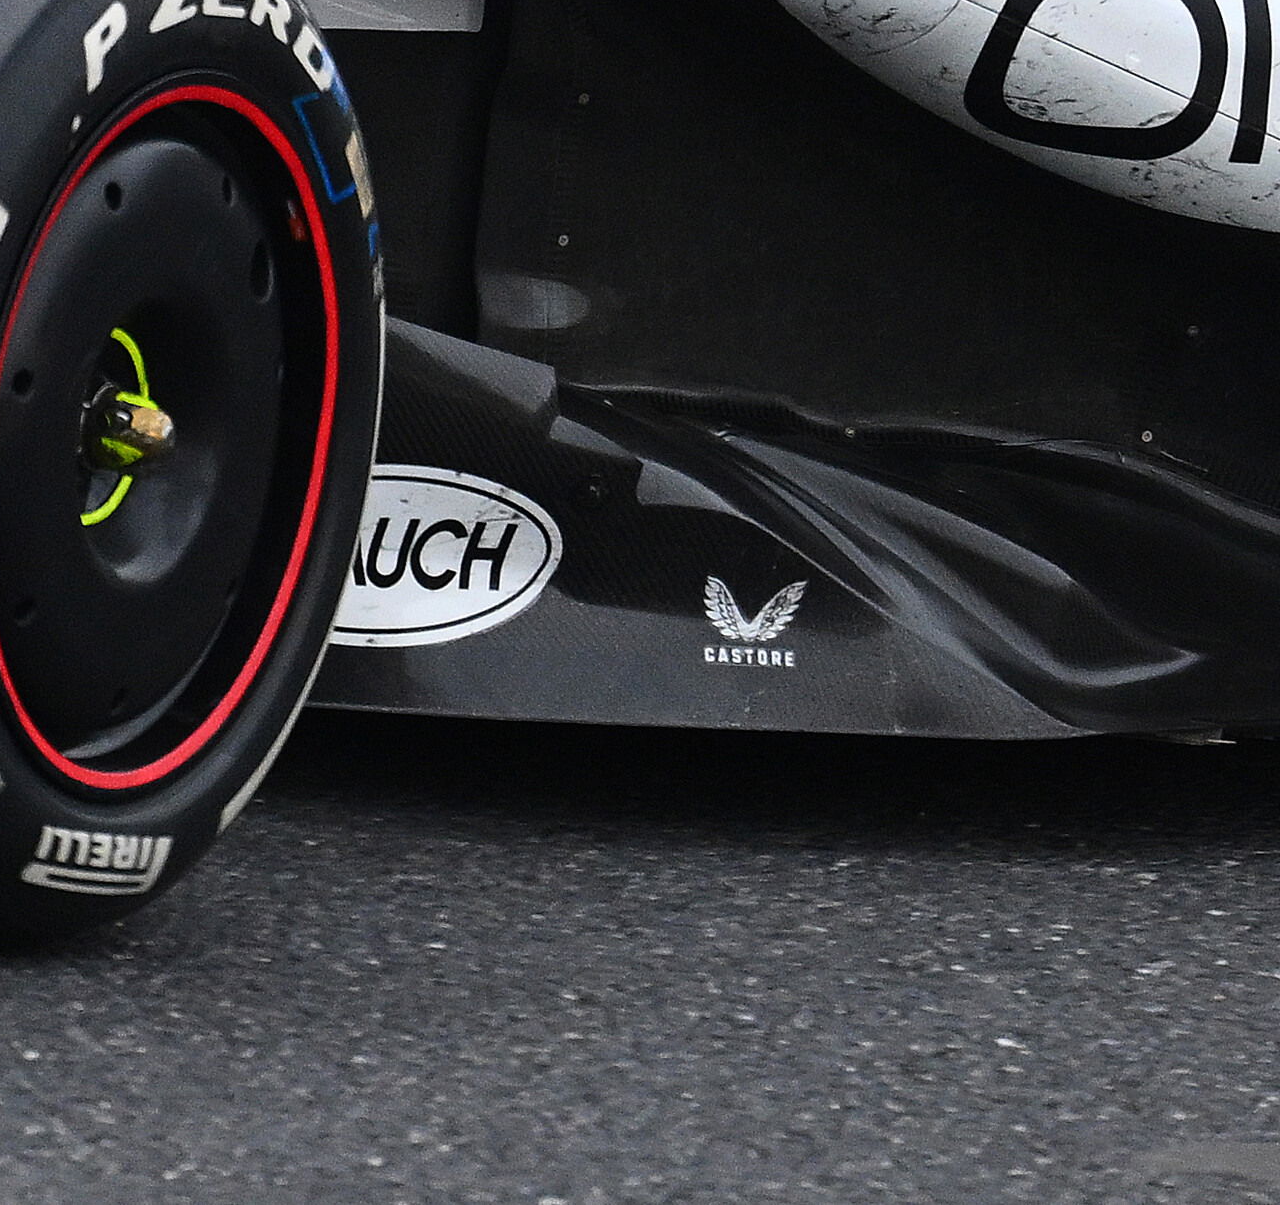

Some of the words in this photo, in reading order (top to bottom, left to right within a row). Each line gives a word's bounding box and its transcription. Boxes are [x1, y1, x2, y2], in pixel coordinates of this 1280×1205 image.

[82, 0, 128, 94] P
[352, 517, 517, 592] UCH
[704, 647, 795, 667] CASTORE
[21, 825, 173, 896] PIRELLI
